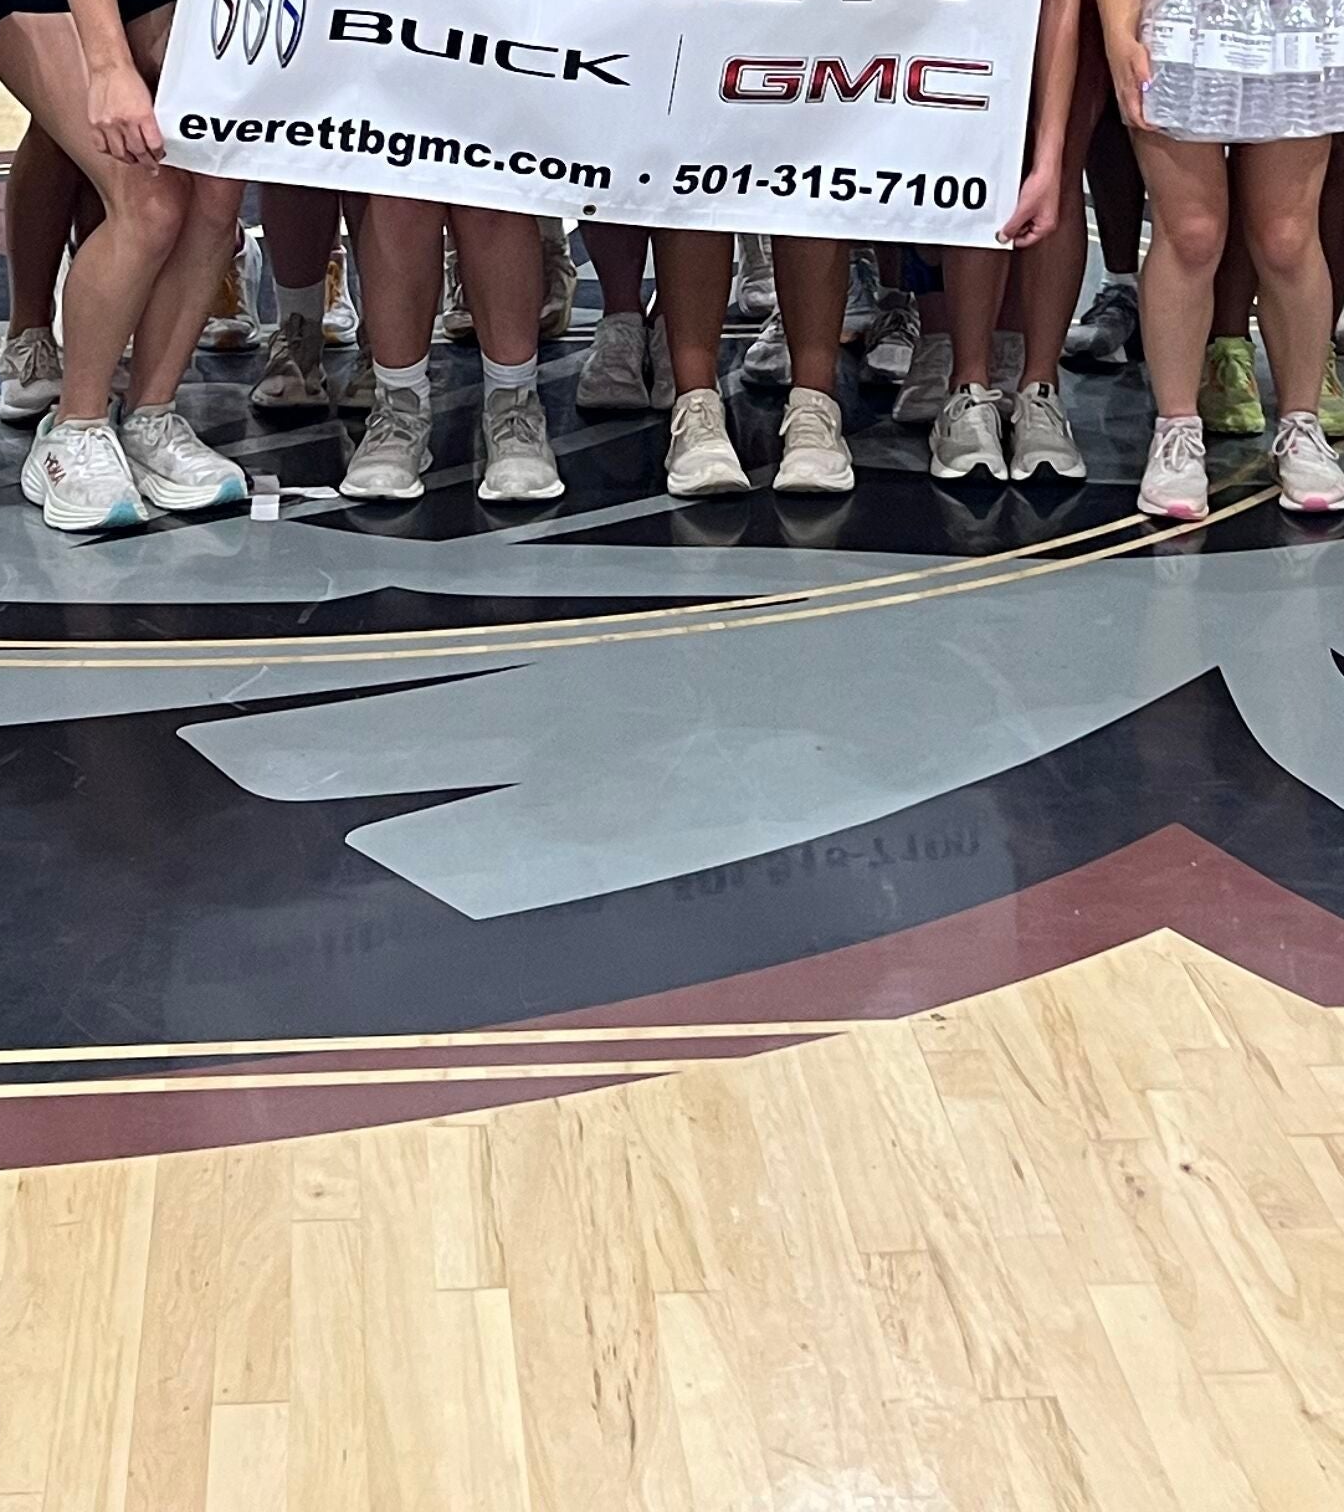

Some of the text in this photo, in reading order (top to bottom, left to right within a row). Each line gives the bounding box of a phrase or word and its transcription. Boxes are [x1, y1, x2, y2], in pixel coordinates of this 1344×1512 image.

[328, 8, 993, 112] BUICK GMC
[179, 112, 988, 210] everettbgmc.com 501-315-7100
